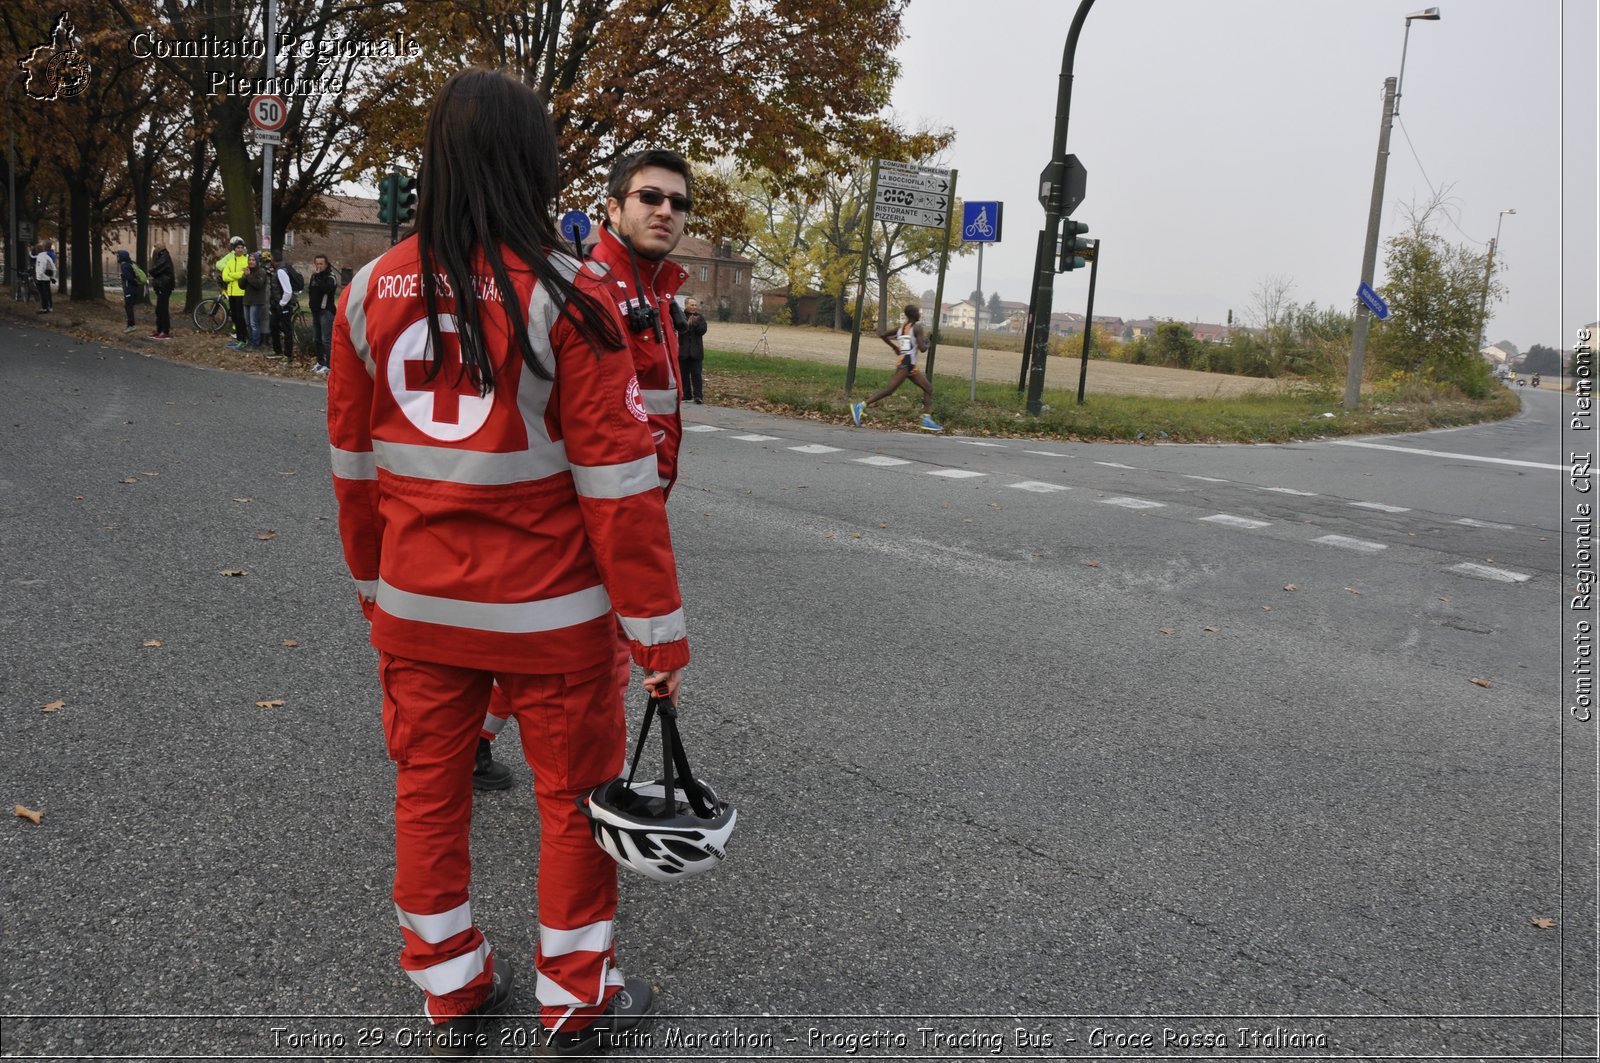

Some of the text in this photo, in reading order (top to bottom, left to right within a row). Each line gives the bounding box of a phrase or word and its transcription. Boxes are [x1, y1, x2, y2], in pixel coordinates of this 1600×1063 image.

[259, 102, 279, 121] 50
[883, 161, 908, 169] COMUNE
[918, 166, 949, 176] NICHELINO
[889, 176, 924, 186] BOCCIOFILA
[876, 205, 918, 216] RISTORANTE
[875, 213, 906, 222] PIZZERIA
[377, 273, 418, 300] CROCE
